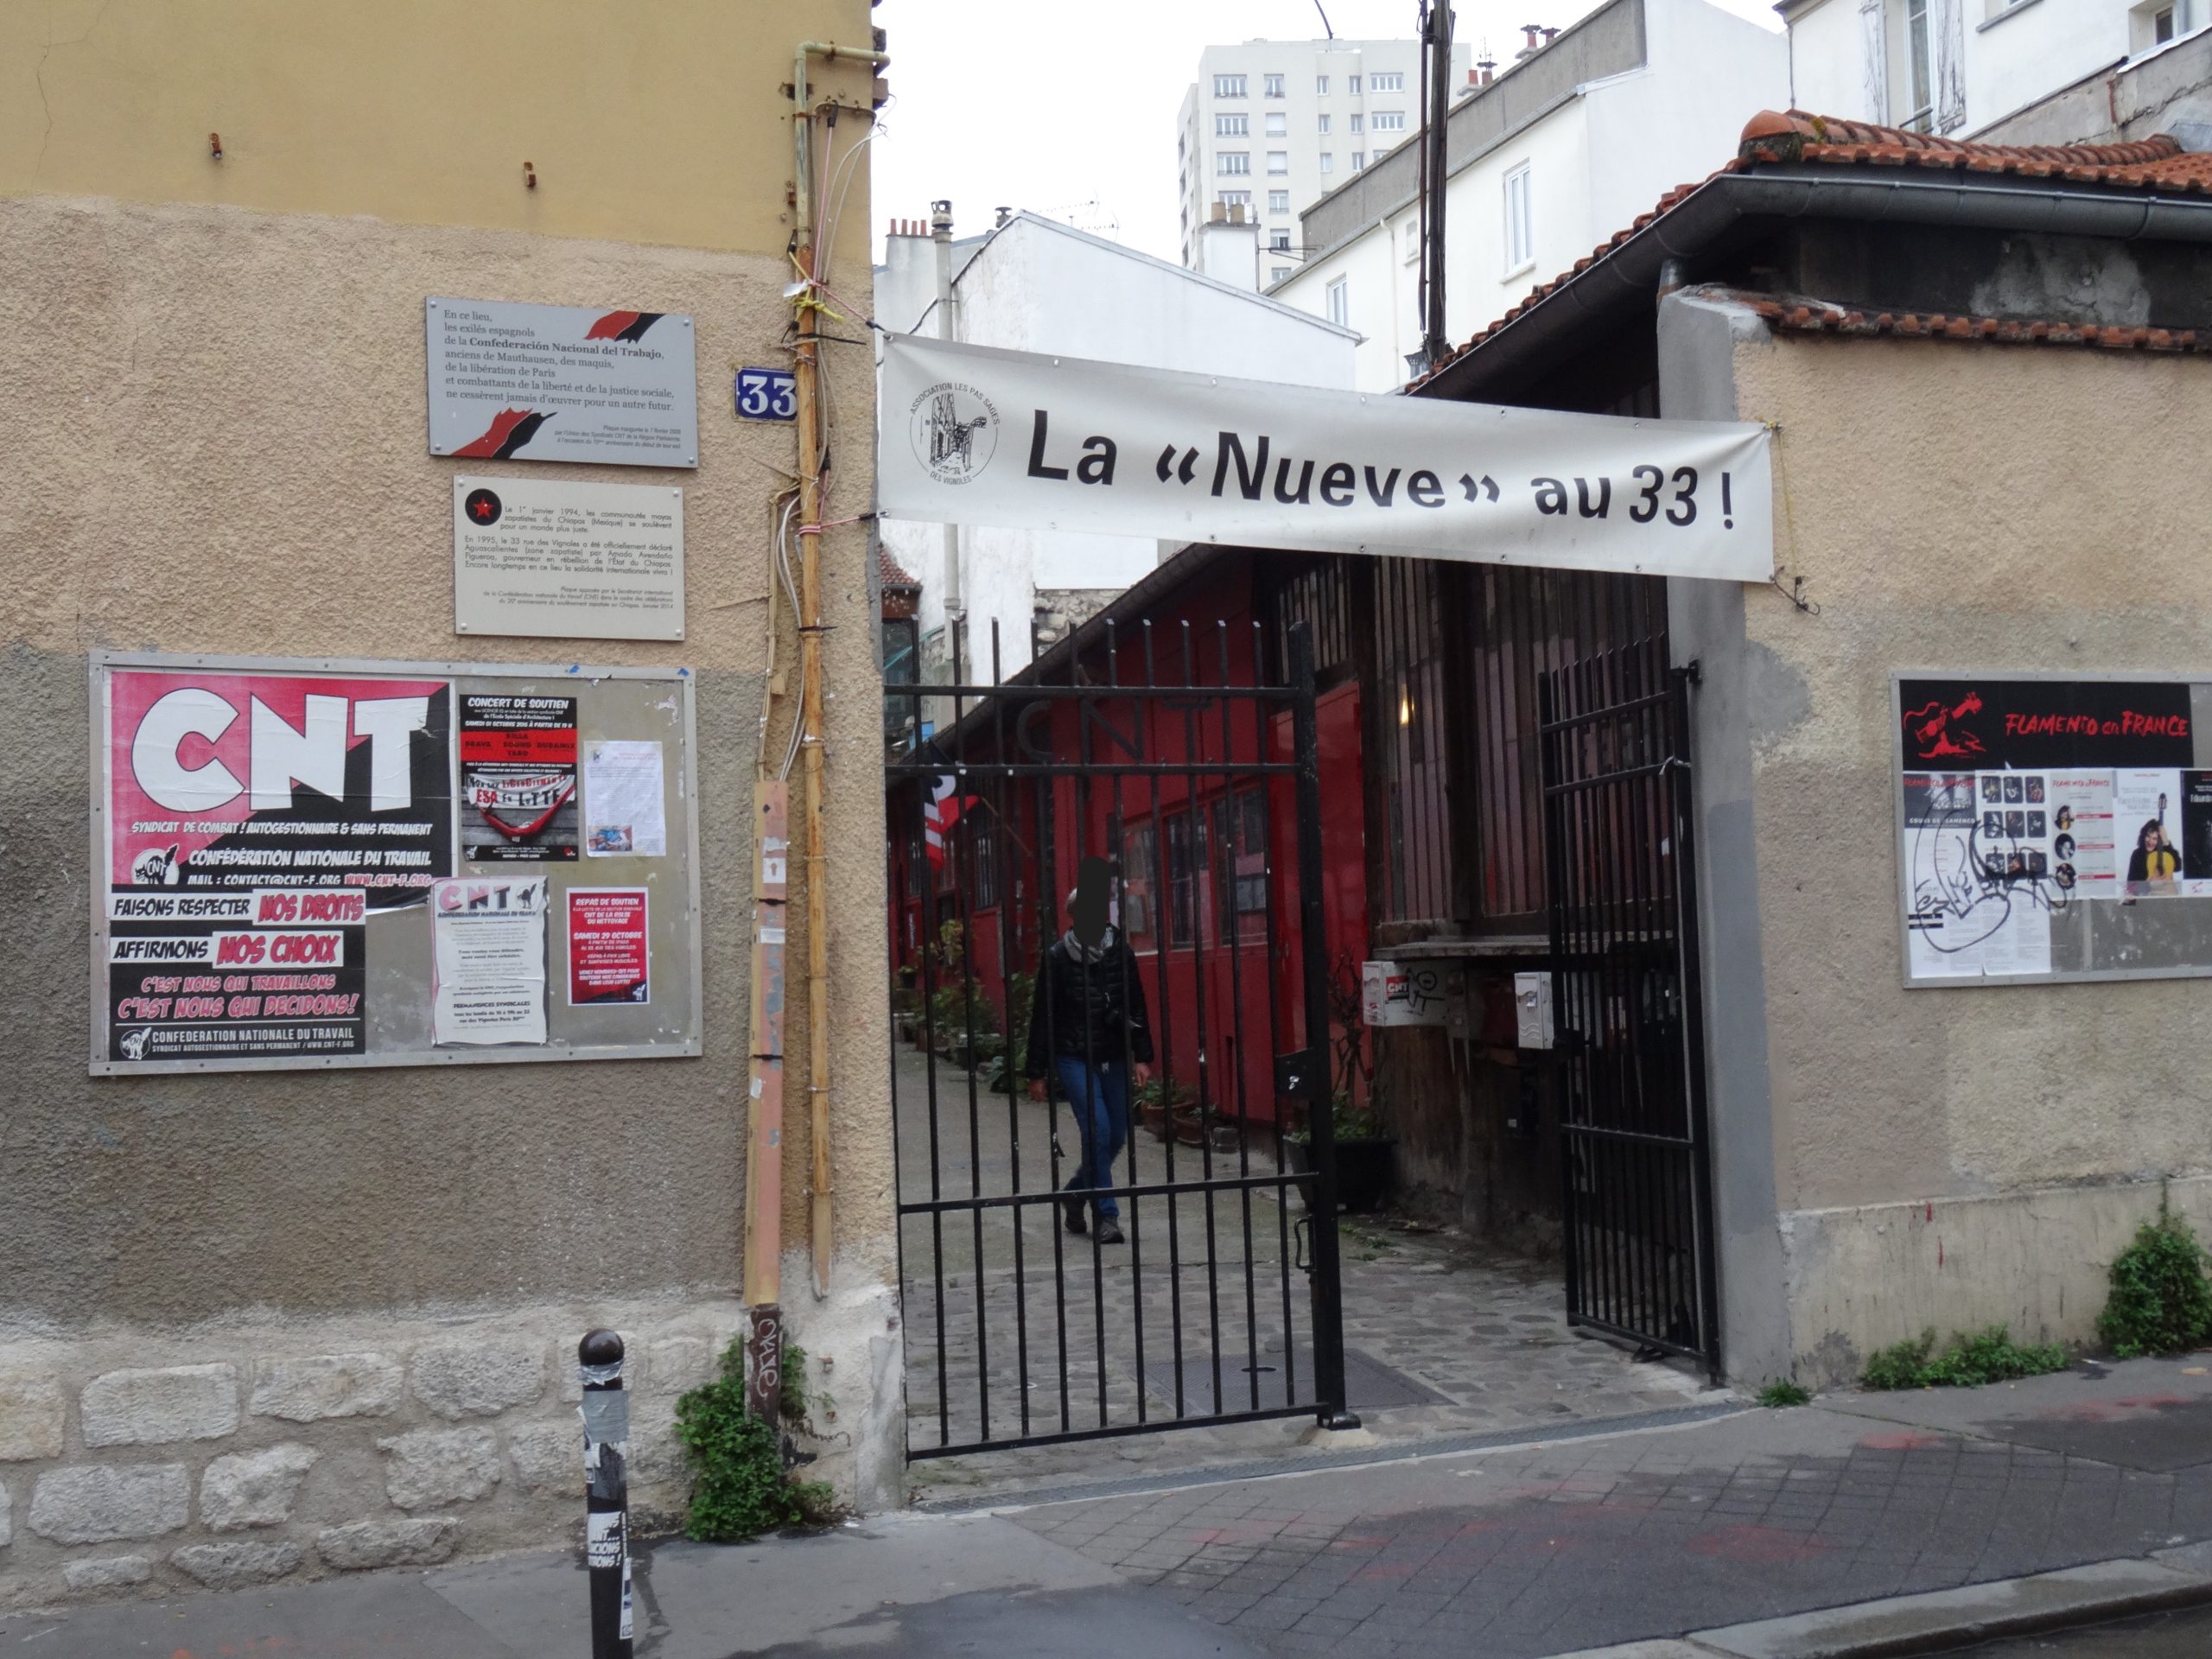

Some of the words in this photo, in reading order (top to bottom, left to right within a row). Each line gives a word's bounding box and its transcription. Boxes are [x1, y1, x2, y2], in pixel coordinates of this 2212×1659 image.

[444, 309, 456, 319] En
[472, 311, 493, 322] lieu,
[444, 322, 457, 332] les
[460, 323, 486, 334] exilés
[489, 327, 535, 338] espagnols
[444, 335, 456, 345] de
[458, 336, 467, 346] la
[470, 337, 550, 351] Confederación
[552, 342, 599, 354] Nacional
[601, 346, 617, 356] del
[620, 347, 664, 359] Trabajo,
[446, 350, 480, 359] anciens
[484, 351, 494, 360] de
[498, 353, 558, 365] Mauthausen,
[560, 356, 575, 365] des
[578, 359, 614, 370] maquis,
[446, 362, 456, 372] de
[460, 363, 468, 372] la
[470, 363, 516, 375] libération
[518, 366, 530, 376] de
[532, 368, 556, 378] Paris
[457, 377, 516, 388] combattants
[518, 380, 529, 389] de
[532, 381, 540, 390] la
[543, 381, 572, 391] liberté
[586, 385, 596, 393] de
[600, 385, 607, 394] la
[609, 385, 639, 396] justice
[641, 388, 674, 398] sociale,
[742, 375, 797, 416] 33
[446, 391, 458, 399] ne
[460, 391, 503, 401] cessèrent
[505, 393, 537, 403] jamais
[584, 399, 605, 408] pour
[622, 401, 646, 410] autre
[648, 401, 674, 411] futur.
[910, 382, 952, 415] ASSOCIATION
[955, 383, 968, 392] LES
[969, 387, 983, 400] PAS
[930, 470, 942, 482] DES
[944, 475, 971, 486] VIGNOLES
[1027, 410, 1117, 486] La
[1530, 477, 1611, 518] au
[1630, 465, 1698, 526] 33
[551, 539, 579, 548] Vignoles
[468, 697, 512, 708] CONCERT
[514, 698, 527, 709] DE
[529, 699, 569, 709] SOUTIEN
[2122, 710, 2189, 737] FRANCE
[131, 687, 429, 813] CNT
[131, 822, 178, 833] SYNDICAT
[183, 822, 196, 833] DE
[198, 823, 238, 834] COMBAT
[245, 823, 339, 835] AUTOGESTIONNAIRE
[351, 823, 377, 835] SANS
[378, 823, 433, 836] PERMANENT
[188, 848, 293, 866] CONFÉDÉRATION
[294, 850, 363, 866] NATIONALE
[363, 851, 382, 866] DU
[385, 851, 432, 866] TRAVAIL
[146, 861, 166, 876] CNT
[188, 874, 213, 885] MAIL
[224, 874, 340, 885] CONTACT@CNT-F.ORG
[344, 874, 432, 887] WWW.CNT-F.ORG
[114, 898, 175, 916] FAISONS
[178, 899, 251, 916] RESPECTER
[257, 893, 297, 923] NOS
[300, 893, 365, 922] DROITS
[439, 885, 512, 911] CNT
[113, 940, 209, 959] AFFIRMONS
[217, 934, 266, 965] NOS
[270, 934, 340, 964] CHOIX
[141, 976, 182, 993] C'EST
[182, 976, 221, 993] NOUS
[223, 975, 249, 993] QUI
[251, 974, 336, 991] TRAVAILLONS
[118, 997, 173, 1019] C'EST
[174, 996, 225, 1019] NOUS
[228, 995, 261, 1018] QUI
[264, 994, 359, 1016] DECIDONS!
[152, 1030, 237, 1043] CONFEDERATION
[238, 1029, 294, 1040] NATIONALE
[297, 1028, 310, 1040] DU
[313, 1027, 354, 1039] TRAVAIL
